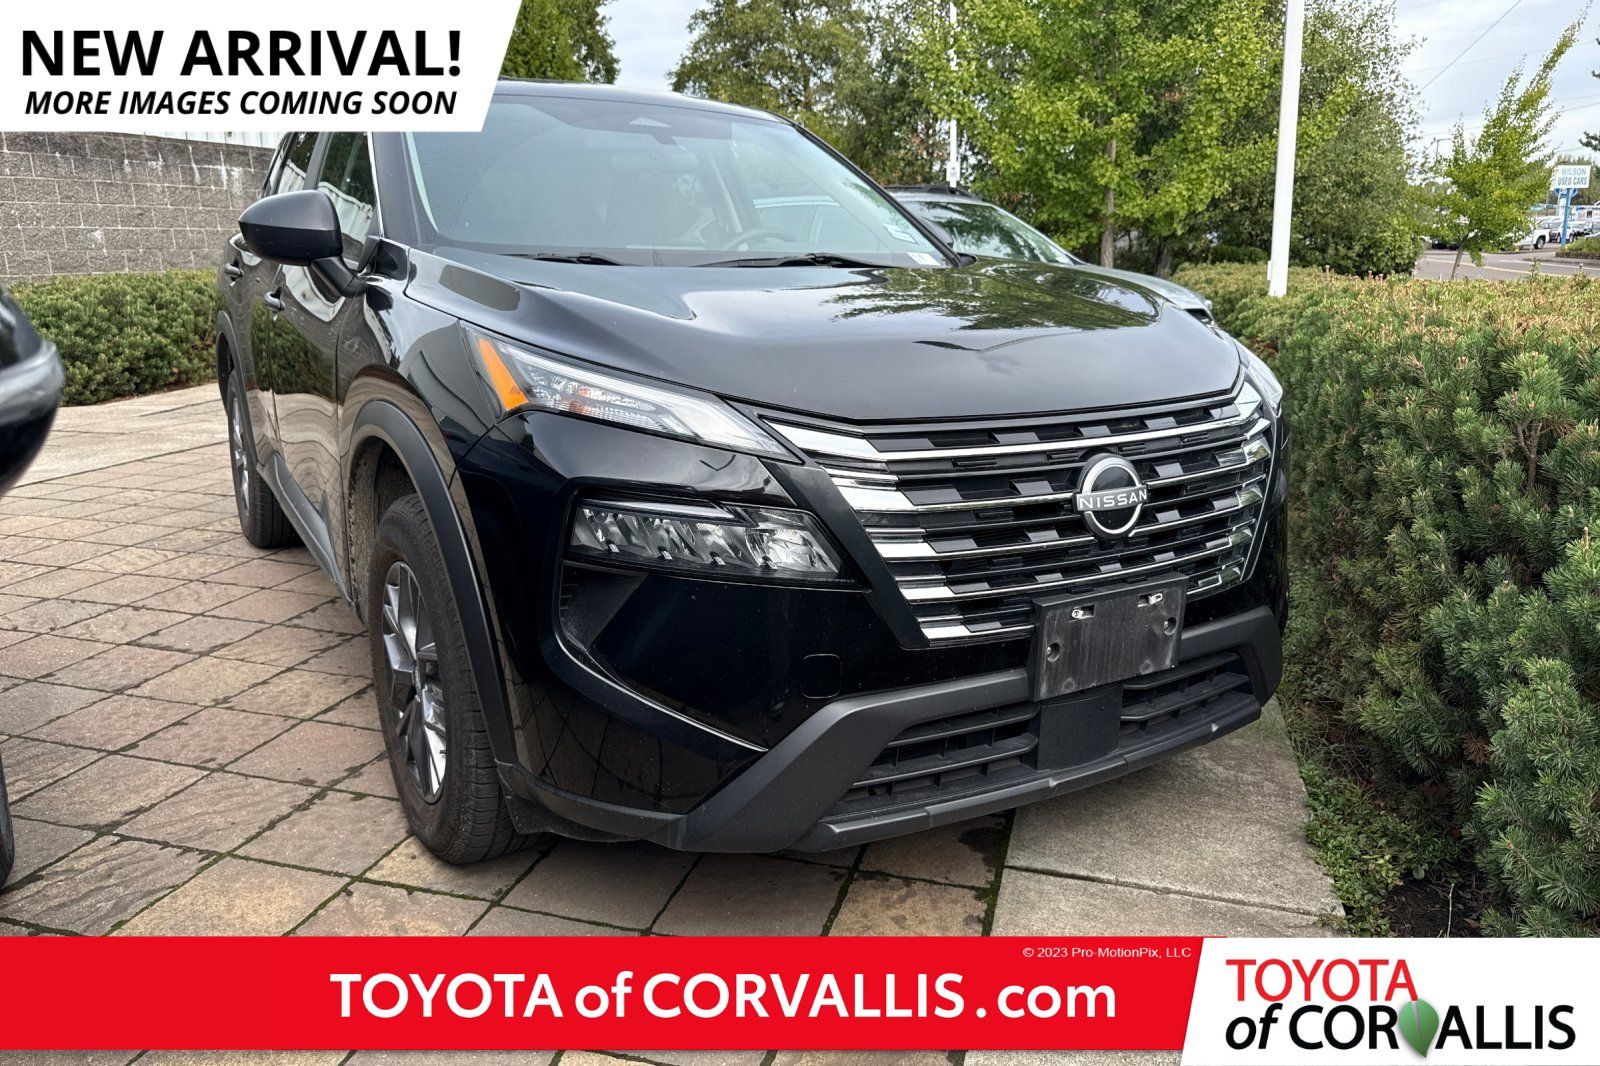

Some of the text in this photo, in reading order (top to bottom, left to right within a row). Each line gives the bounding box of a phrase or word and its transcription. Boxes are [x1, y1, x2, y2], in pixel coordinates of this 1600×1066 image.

[1561, 167, 1587, 176] WILSON
[1557, 177, 1588, 186] USED CARS
[1079, 488, 1148, 509] NISSAN
